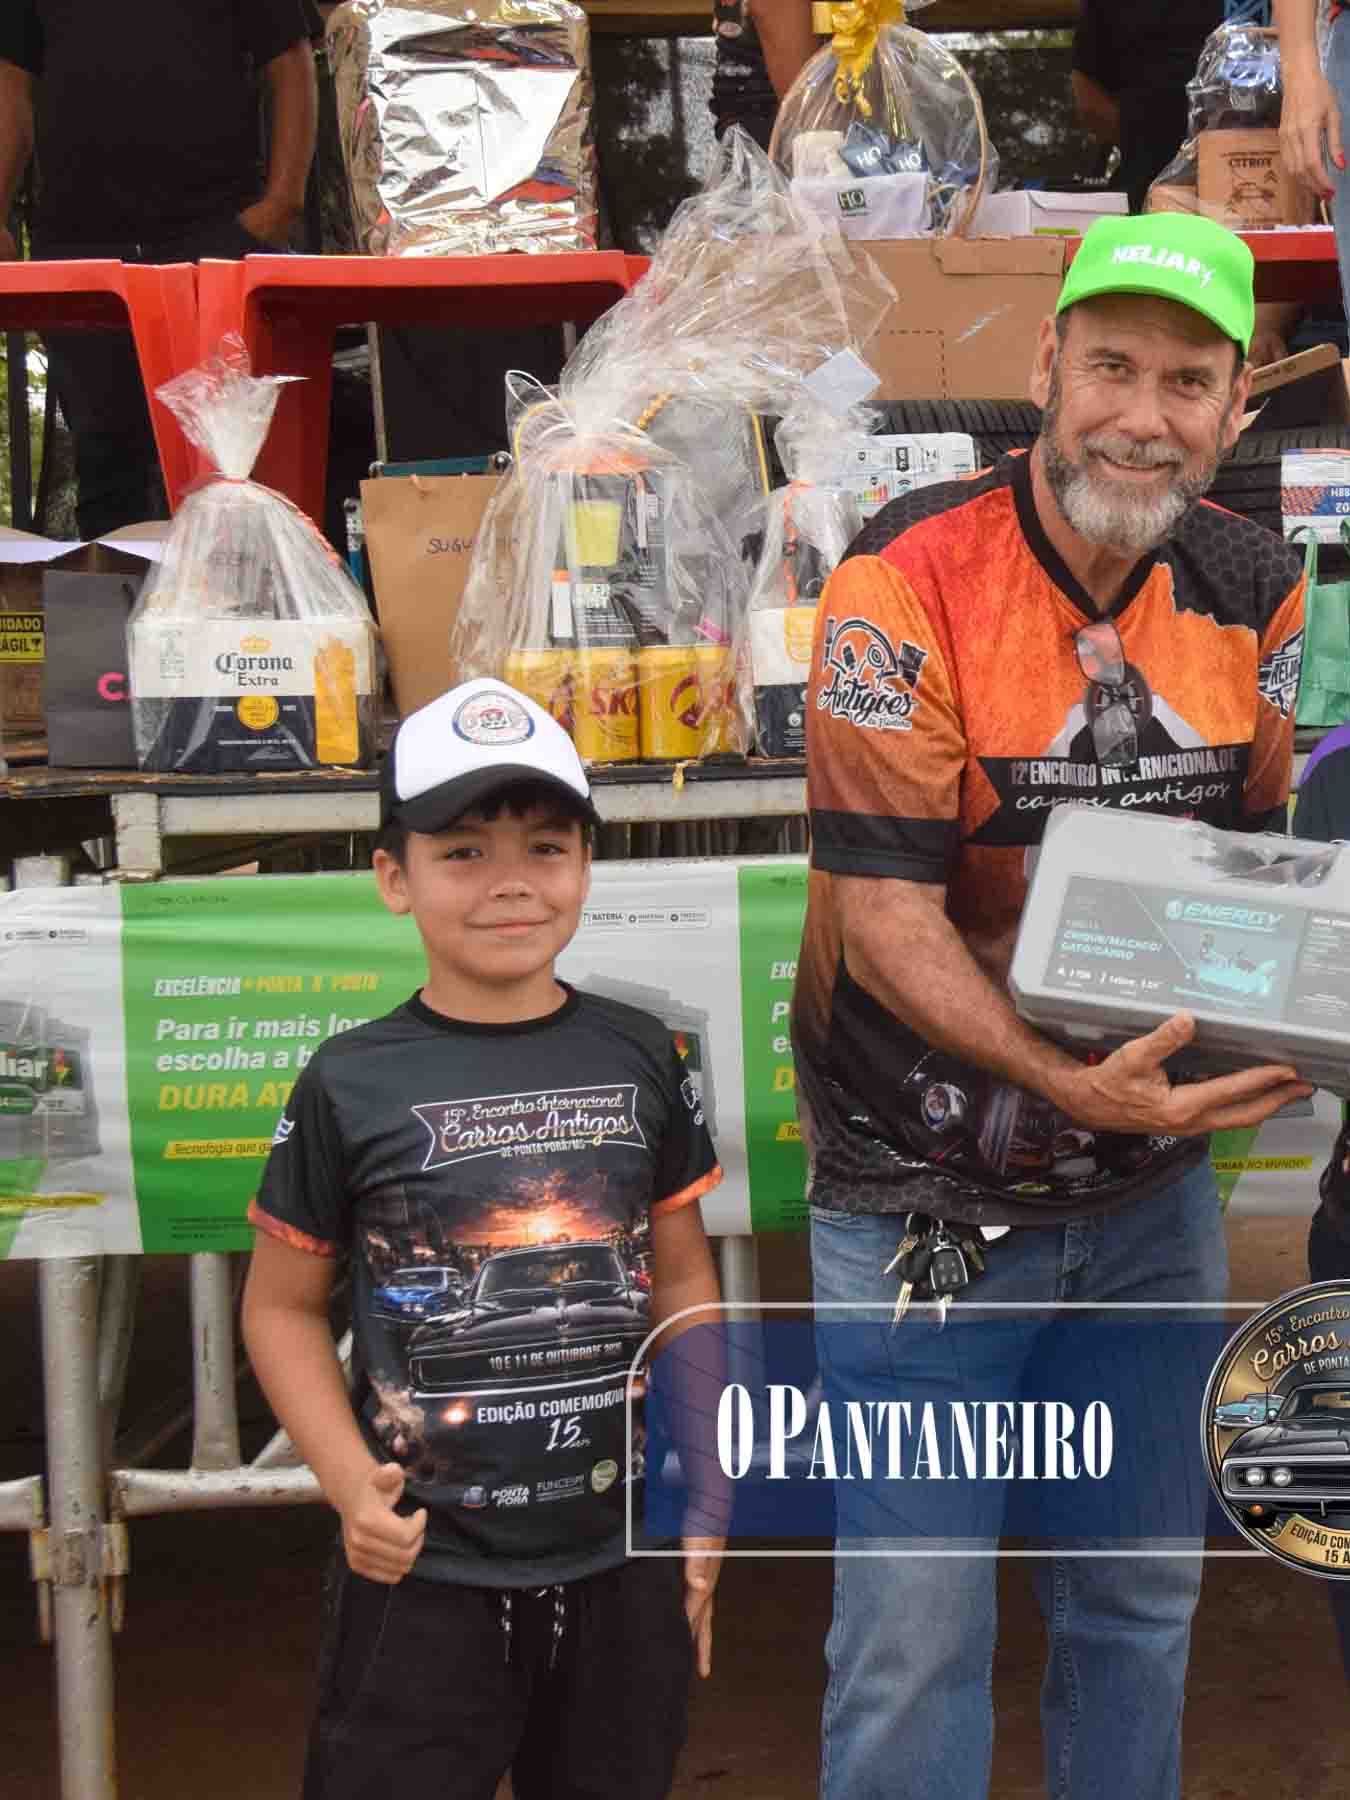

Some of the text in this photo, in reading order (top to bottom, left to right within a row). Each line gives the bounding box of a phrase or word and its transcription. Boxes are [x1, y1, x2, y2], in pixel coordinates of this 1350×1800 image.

[856, 147, 881, 168] HO
[899, 152, 921, 169] HO
[838, 190, 865, 208] HO
[0, 617, 41, 631] IDADO
[215, 652, 294, 674] Corona
[237, 673, 279, 687] Extra
[1120, 781, 1230, 808] antigos
[1181, 902, 1287, 927] ENERGY
[155, 1016, 221, 1042] Para
[226, 1014, 249, 1042] ir
[254, 1013, 322, 1041] mais
[157, 1046, 265, 1073] escolha
[273, 1052, 288, 1069] a
[159, 1082, 292, 1111] DURA AT
[472, 1098, 536, 1120] Encontro
[537, 1092, 625, 1111] Internacional
[440, 1110, 634, 1153] Carros Antigos
[476, 1400, 536, 1425] EDIÇÃO
[545, 1415, 582, 1451] 15
